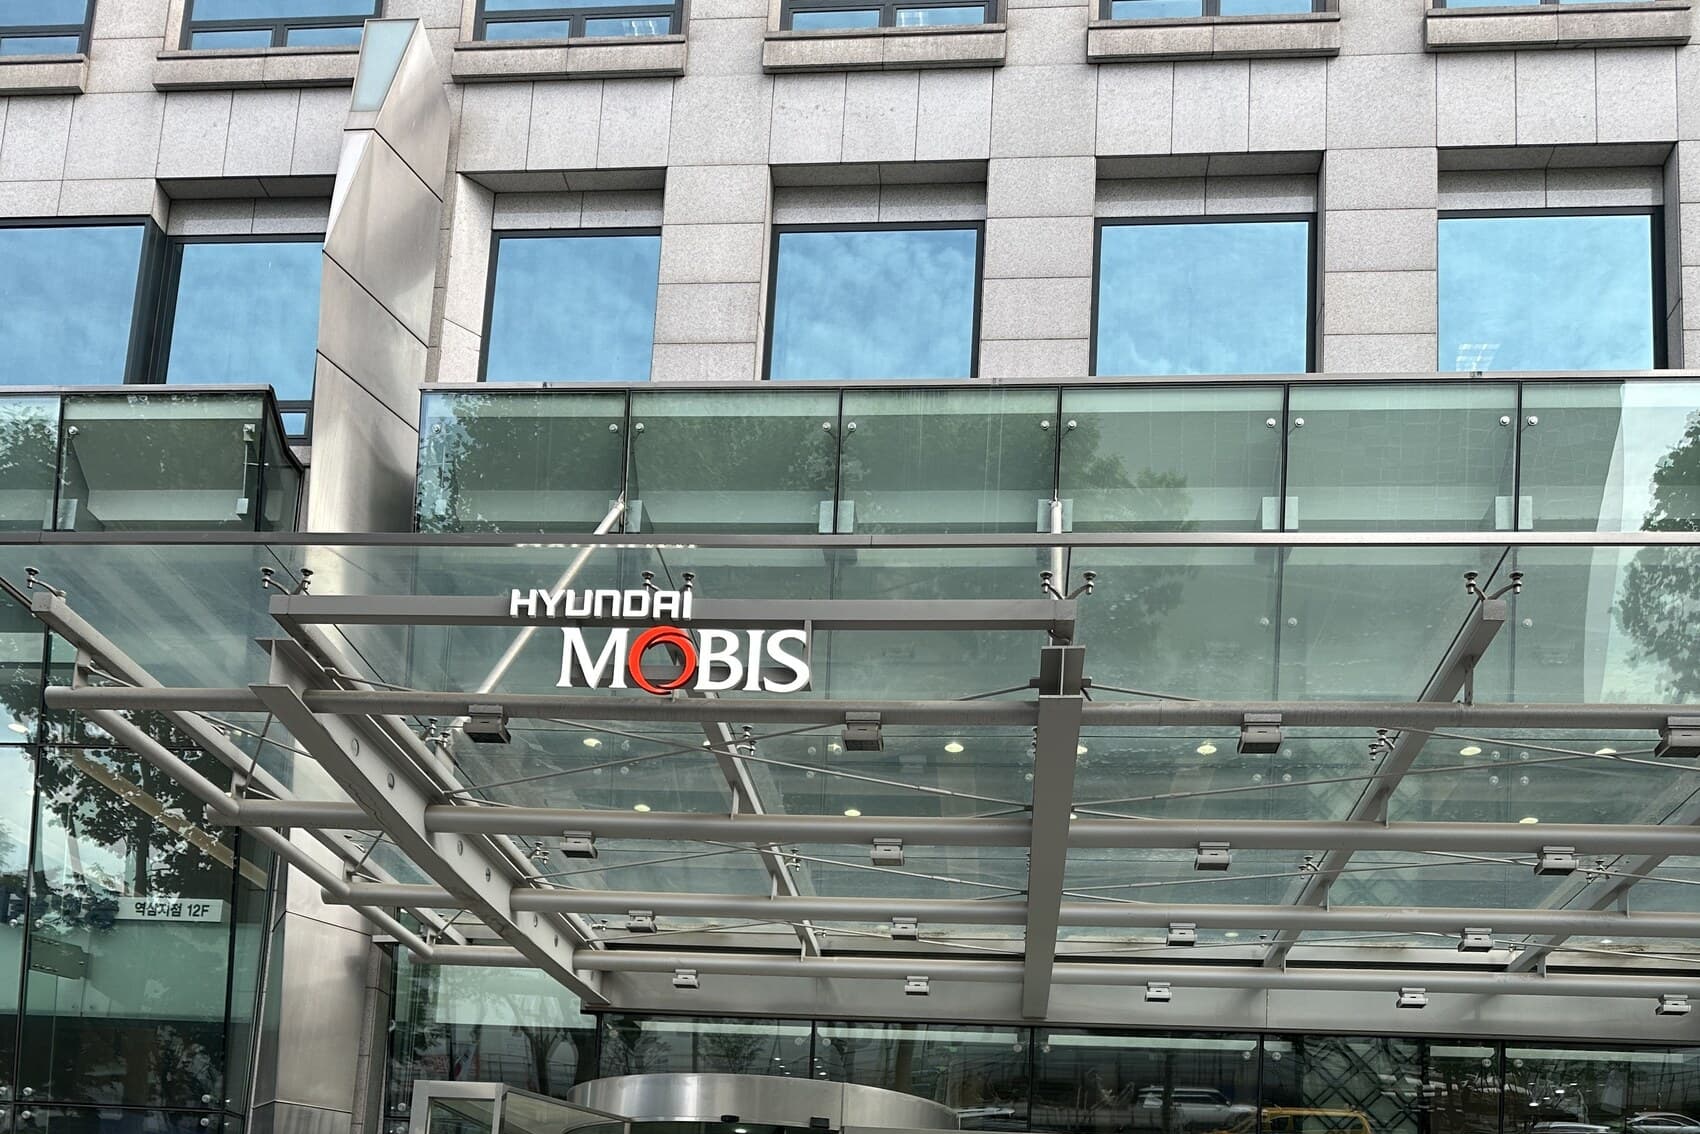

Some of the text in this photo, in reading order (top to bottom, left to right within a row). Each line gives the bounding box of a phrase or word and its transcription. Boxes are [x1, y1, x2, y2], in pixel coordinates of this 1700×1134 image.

[510, 588, 693, 620] HYUNDAI
[556, 625, 810, 695] MOBIS
[135, 902, 210, 917] 역삼지점 12F
